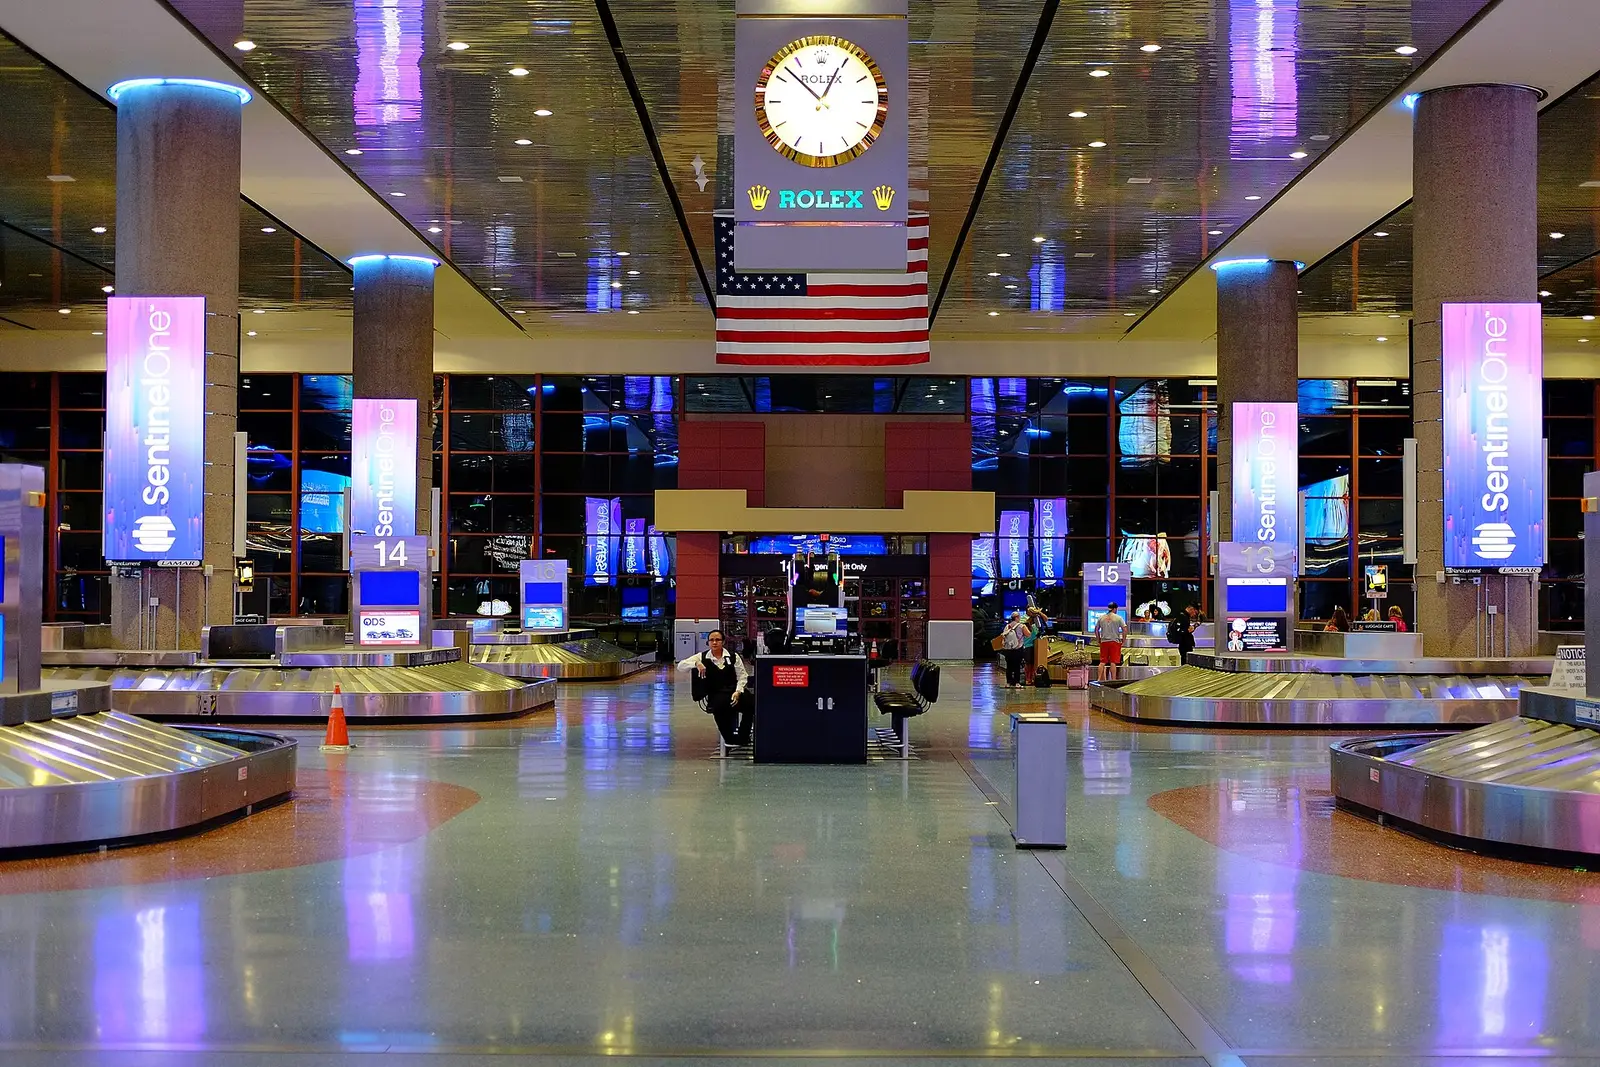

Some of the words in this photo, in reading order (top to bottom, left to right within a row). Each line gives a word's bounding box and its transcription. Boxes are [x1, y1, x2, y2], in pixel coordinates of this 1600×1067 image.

[801, 75, 843, 84] ROLEX
[779, 190, 864, 209] ROLEX
[140, 310, 171, 506] SentinelOne
[1478, 316, 1509, 512] SentinelOne
[375, 408, 395, 537] SentinelOne
[1256, 410, 1276, 541] SentinelOne
[374, 540, 408, 567] 14
[1241, 546, 1275, 573] 13
[533, 562, 556, 580] 16
[851, 563, 867, 571] Only
[1096, 565, 1119, 583] 15
[1561, 648, 1586, 659] NOTICE
